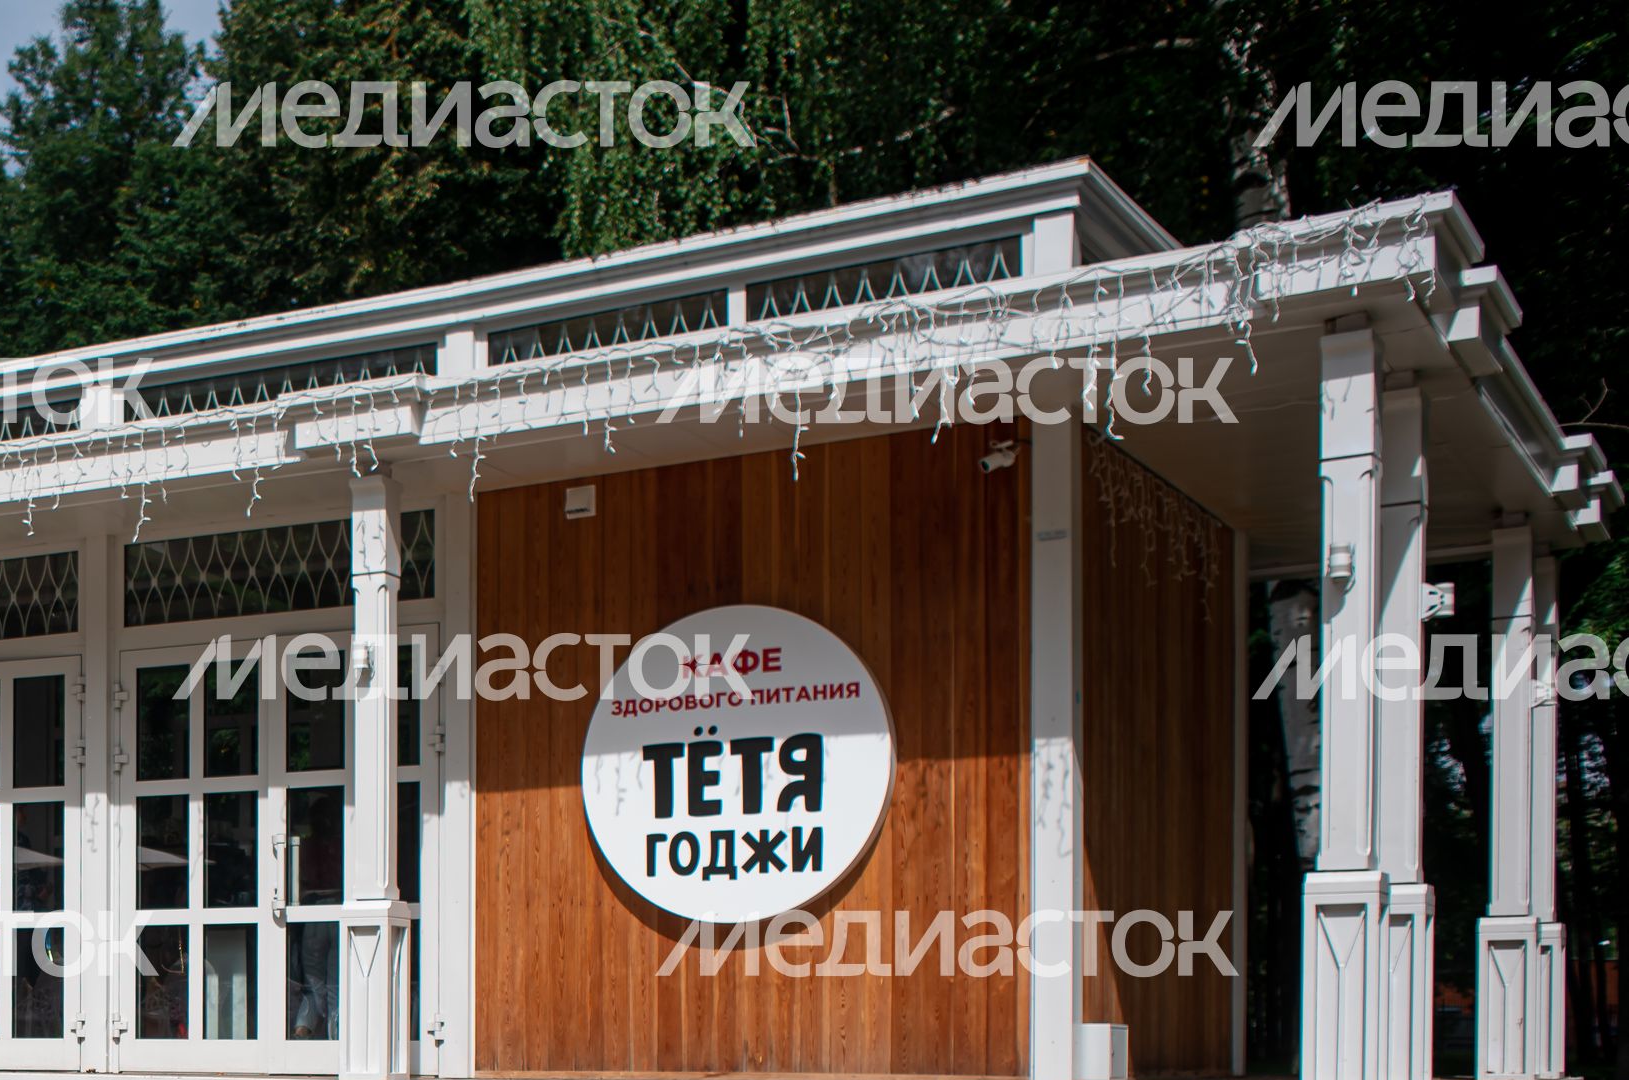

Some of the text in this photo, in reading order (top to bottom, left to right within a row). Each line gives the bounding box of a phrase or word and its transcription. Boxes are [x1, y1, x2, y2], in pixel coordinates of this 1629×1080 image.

[681, 647, 783, 680] КАФЕ
[611, 682, 861, 718] ЗДОРОВОГО ПИТАНИЯ
[642, 725, 824, 819] ТЁТЯ
[646, 826, 824, 881] ГОДЖИ
